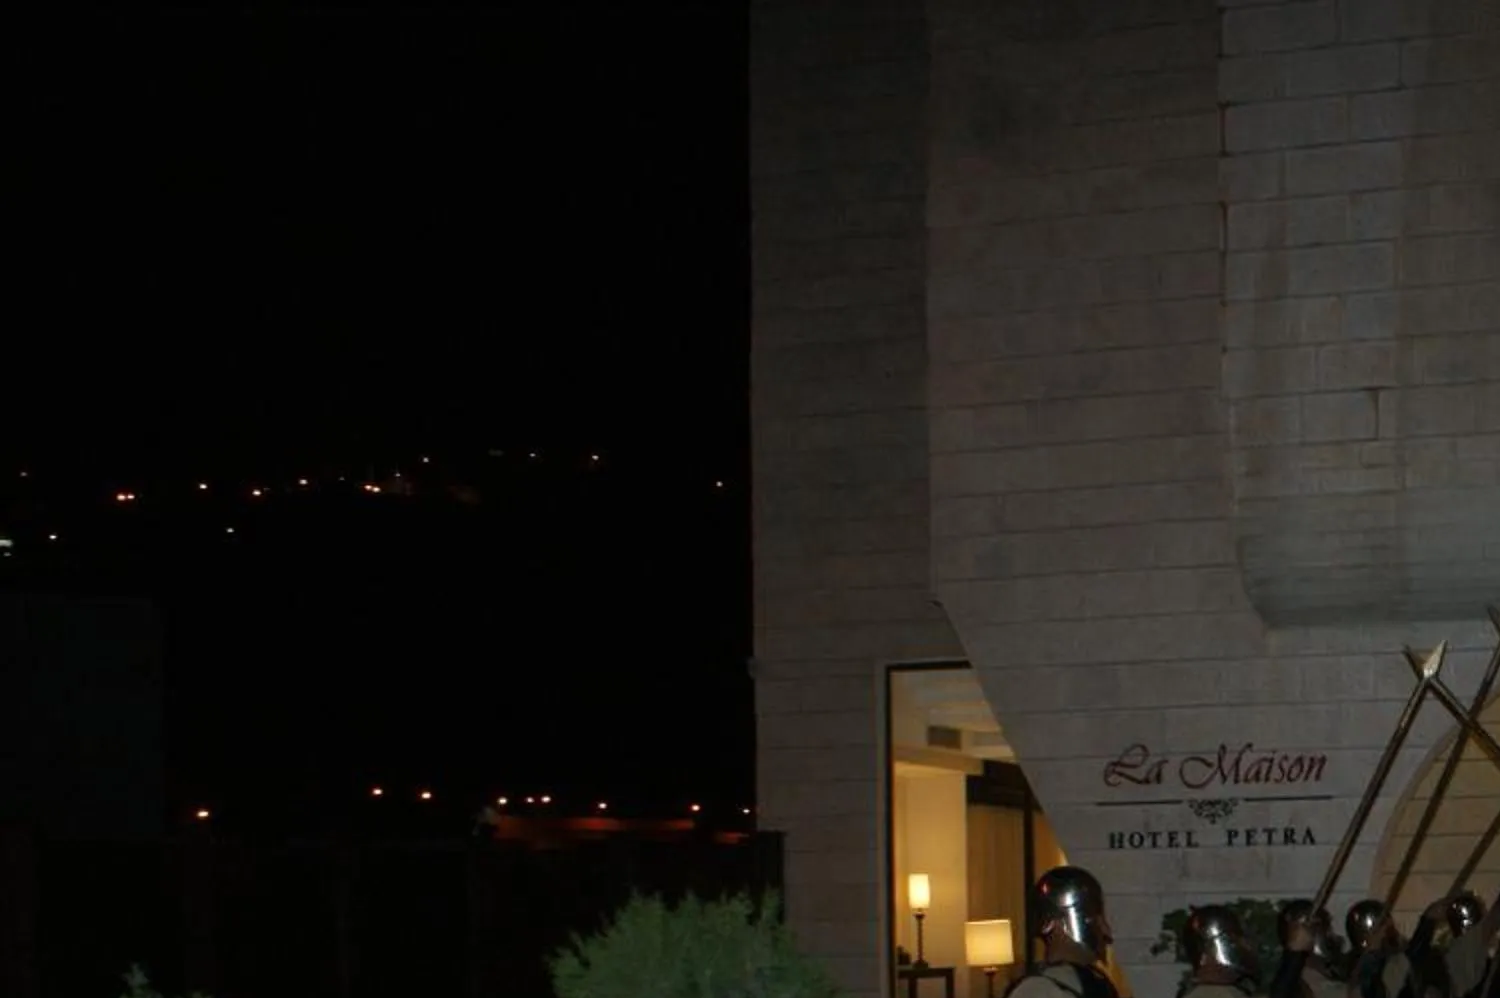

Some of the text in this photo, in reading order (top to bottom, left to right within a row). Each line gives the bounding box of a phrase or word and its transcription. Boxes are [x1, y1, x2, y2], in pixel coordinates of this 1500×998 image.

[1103, 742, 1328, 789] La Maison
[1109, 826, 1317, 849] HOTEL PETRA
